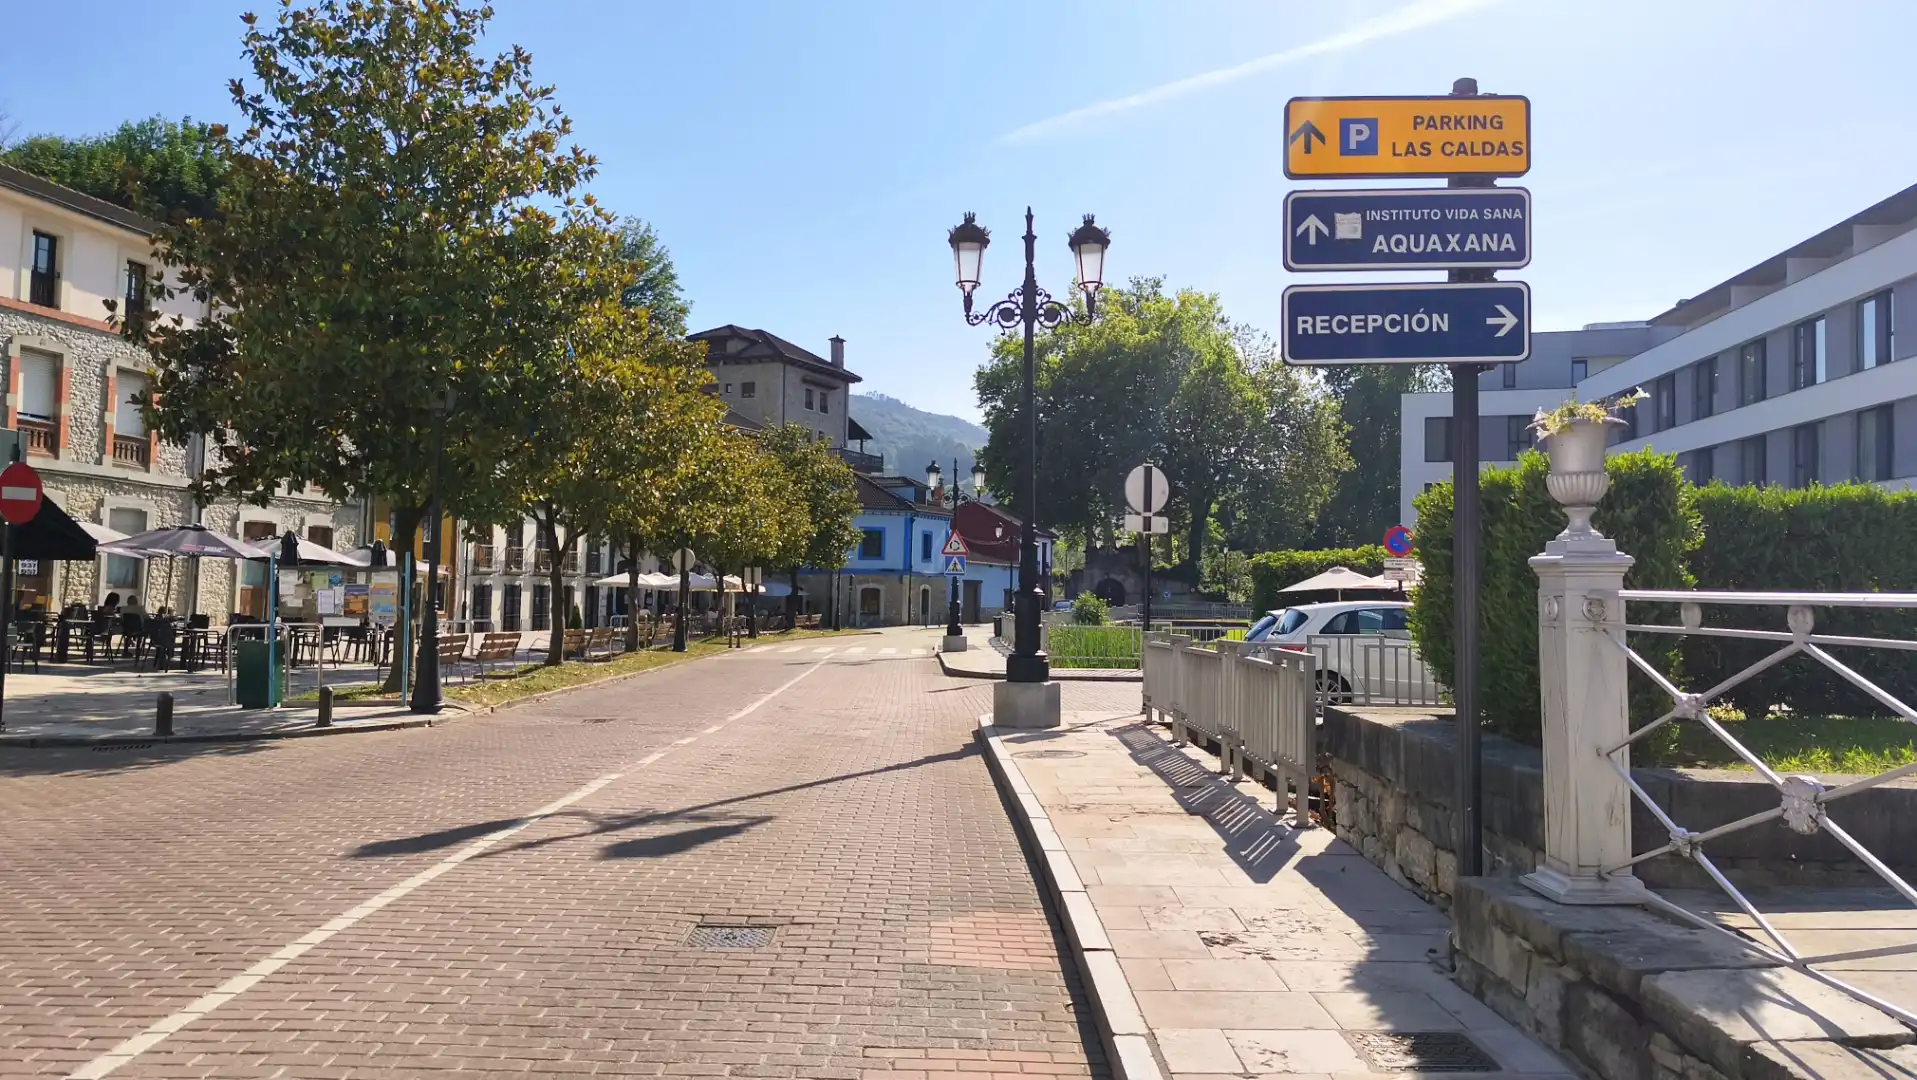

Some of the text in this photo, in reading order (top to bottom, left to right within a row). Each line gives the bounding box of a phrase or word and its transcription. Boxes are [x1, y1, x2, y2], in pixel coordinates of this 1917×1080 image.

[1413, 115, 1503, 130] PARKING
[1349, 123, 1370, 149] P
[1392, 140, 1524, 157] LAS CALDAS
[1366, 207, 1523, 221] INSTITUTO VIDA SANA
[1372, 233, 1517, 253] AQUAXANA
[1297, 308, 1449, 335] RECEPCIÓN
